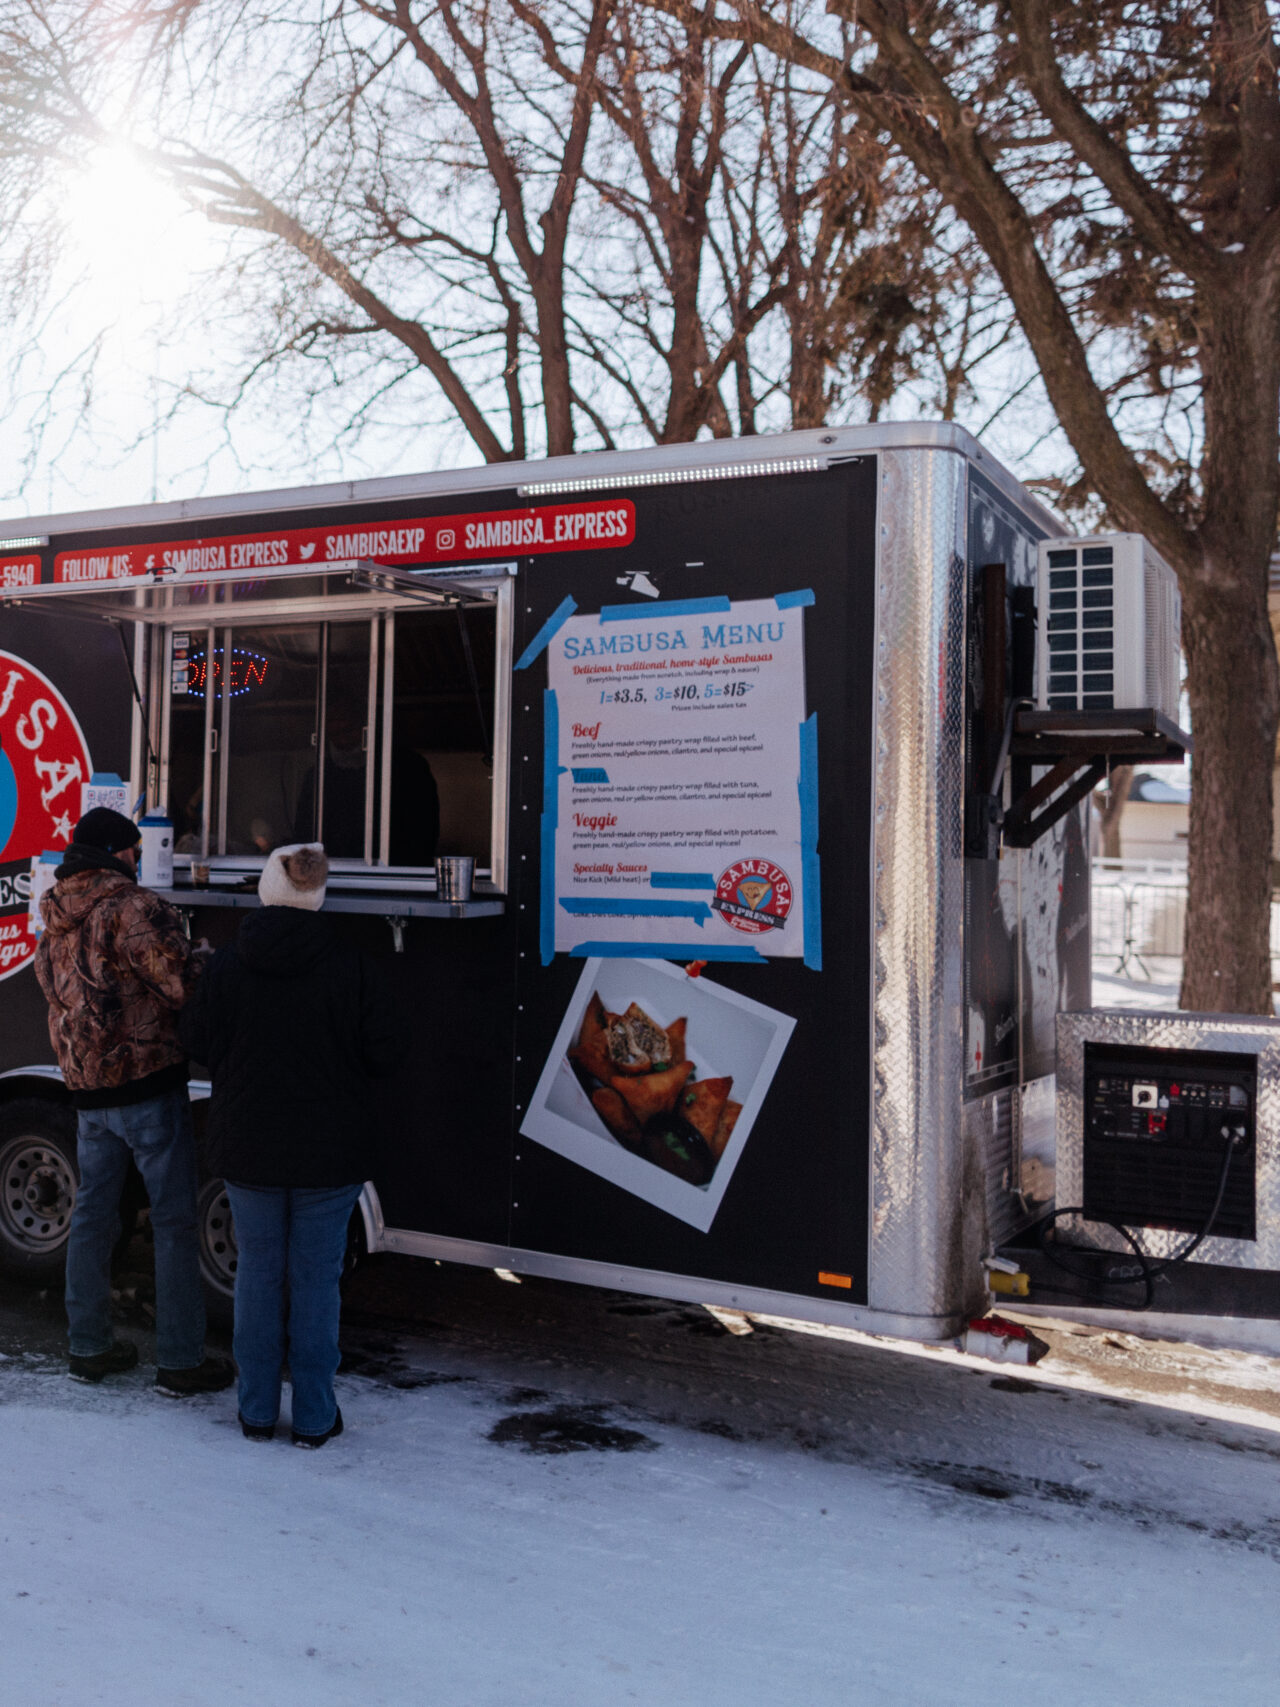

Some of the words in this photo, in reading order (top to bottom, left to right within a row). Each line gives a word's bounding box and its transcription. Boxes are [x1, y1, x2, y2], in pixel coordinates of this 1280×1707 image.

[465, 510, 627, 549] SAMBUSA_EXPRESS
[326, 528, 425, 560] SAMBUSAEXP
[62, 557, 108, 582] FOLLOW
[112, 555, 133, 577] US:
[163, 546, 226, 572] SAMBUSA
[229, 539, 289, 569] EXPRESS
[616, 660, 667, 672] traditional,
[722, 652, 773, 664] Sambusas
[685, 669, 713, 677] including
[572, 721, 602, 741] Beef
[572, 742, 596, 750] Freshly
[598, 739, 634, 748] hand-made
[636, 739, 657, 748] crispy
[658, 738, 683, 747] pastry
[739, 733, 756, 741] beef,
[714, 745, 737, 755] special
[572, 786, 596, 794] Freshly
[659, 783, 683, 793] pastry
[572, 797, 590, 805] green
[634, 795, 653, 803] yellow
[722, 792, 746, 801] special
[573, 812, 618, 831] Veggie
[659, 829, 684, 838] pastry
[573, 842, 591, 850] green
[689, 840, 714, 848] special
[573, 862, 614, 875] Specialty
[616, 862, 648, 873] Sauces
[604, 876, 621, 885] (Mild
[622, 876, 641, 884] heat)
[720, 861, 789, 905] SAMBUSA
[720, 902, 775, 924] EXPRESS
